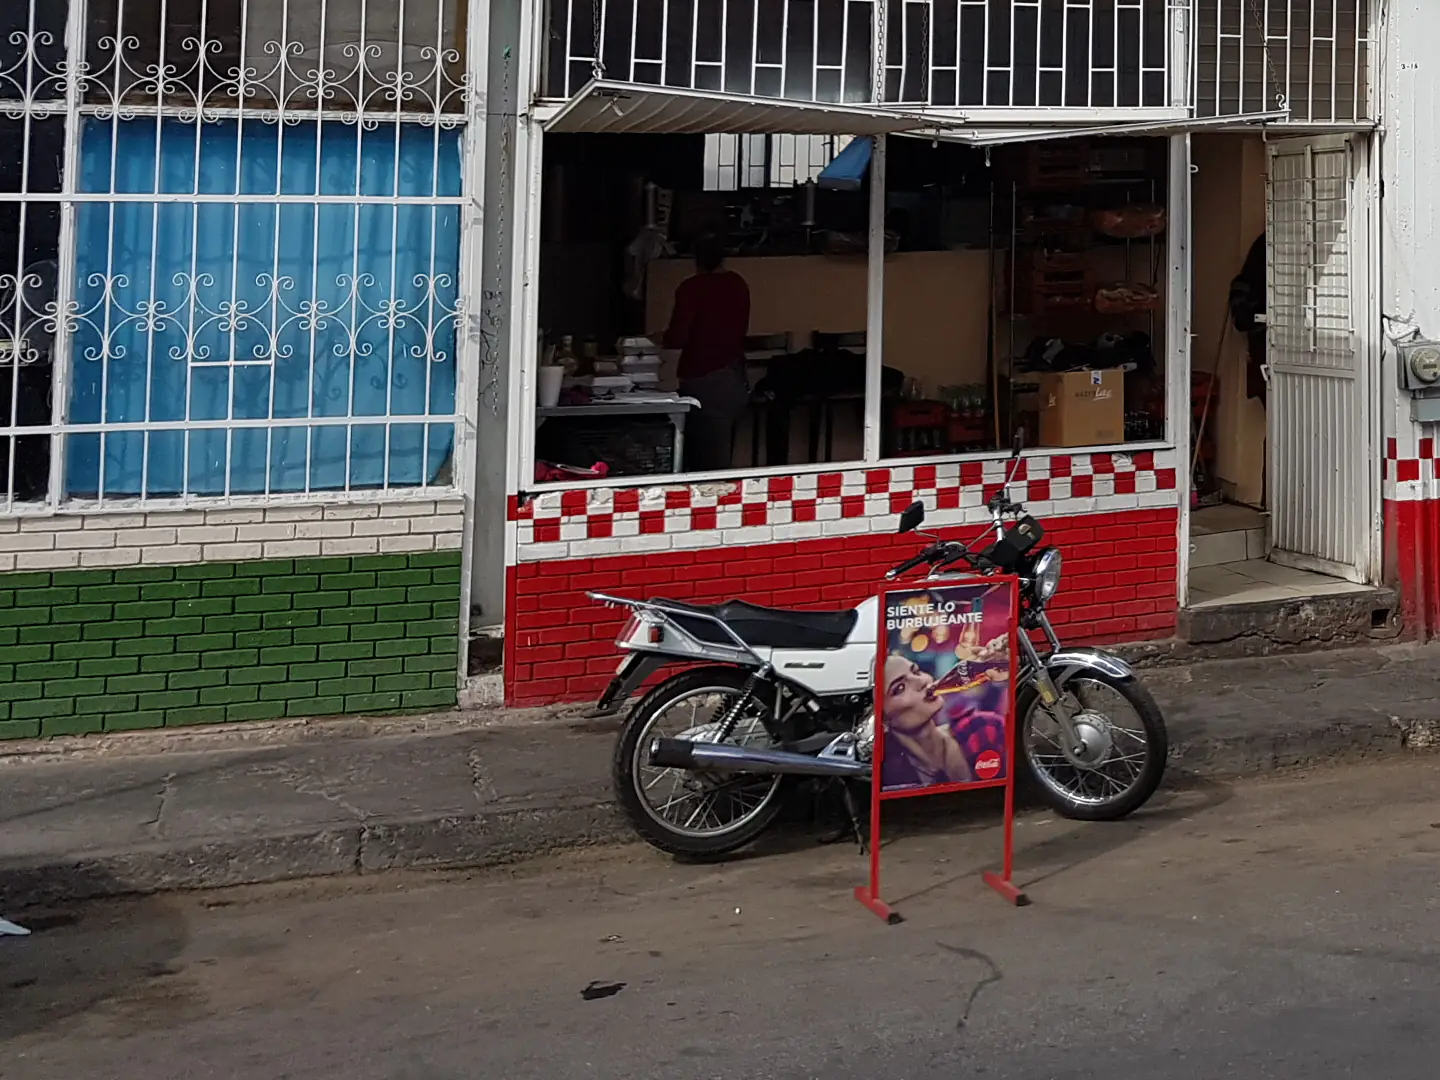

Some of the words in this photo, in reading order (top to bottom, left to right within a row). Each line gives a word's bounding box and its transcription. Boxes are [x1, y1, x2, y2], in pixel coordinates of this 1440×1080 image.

[887, 602, 935, 617] SIENTE
[938, 601, 956, 613] LO
[887, 612, 983, 630] BURBUJEANTE
